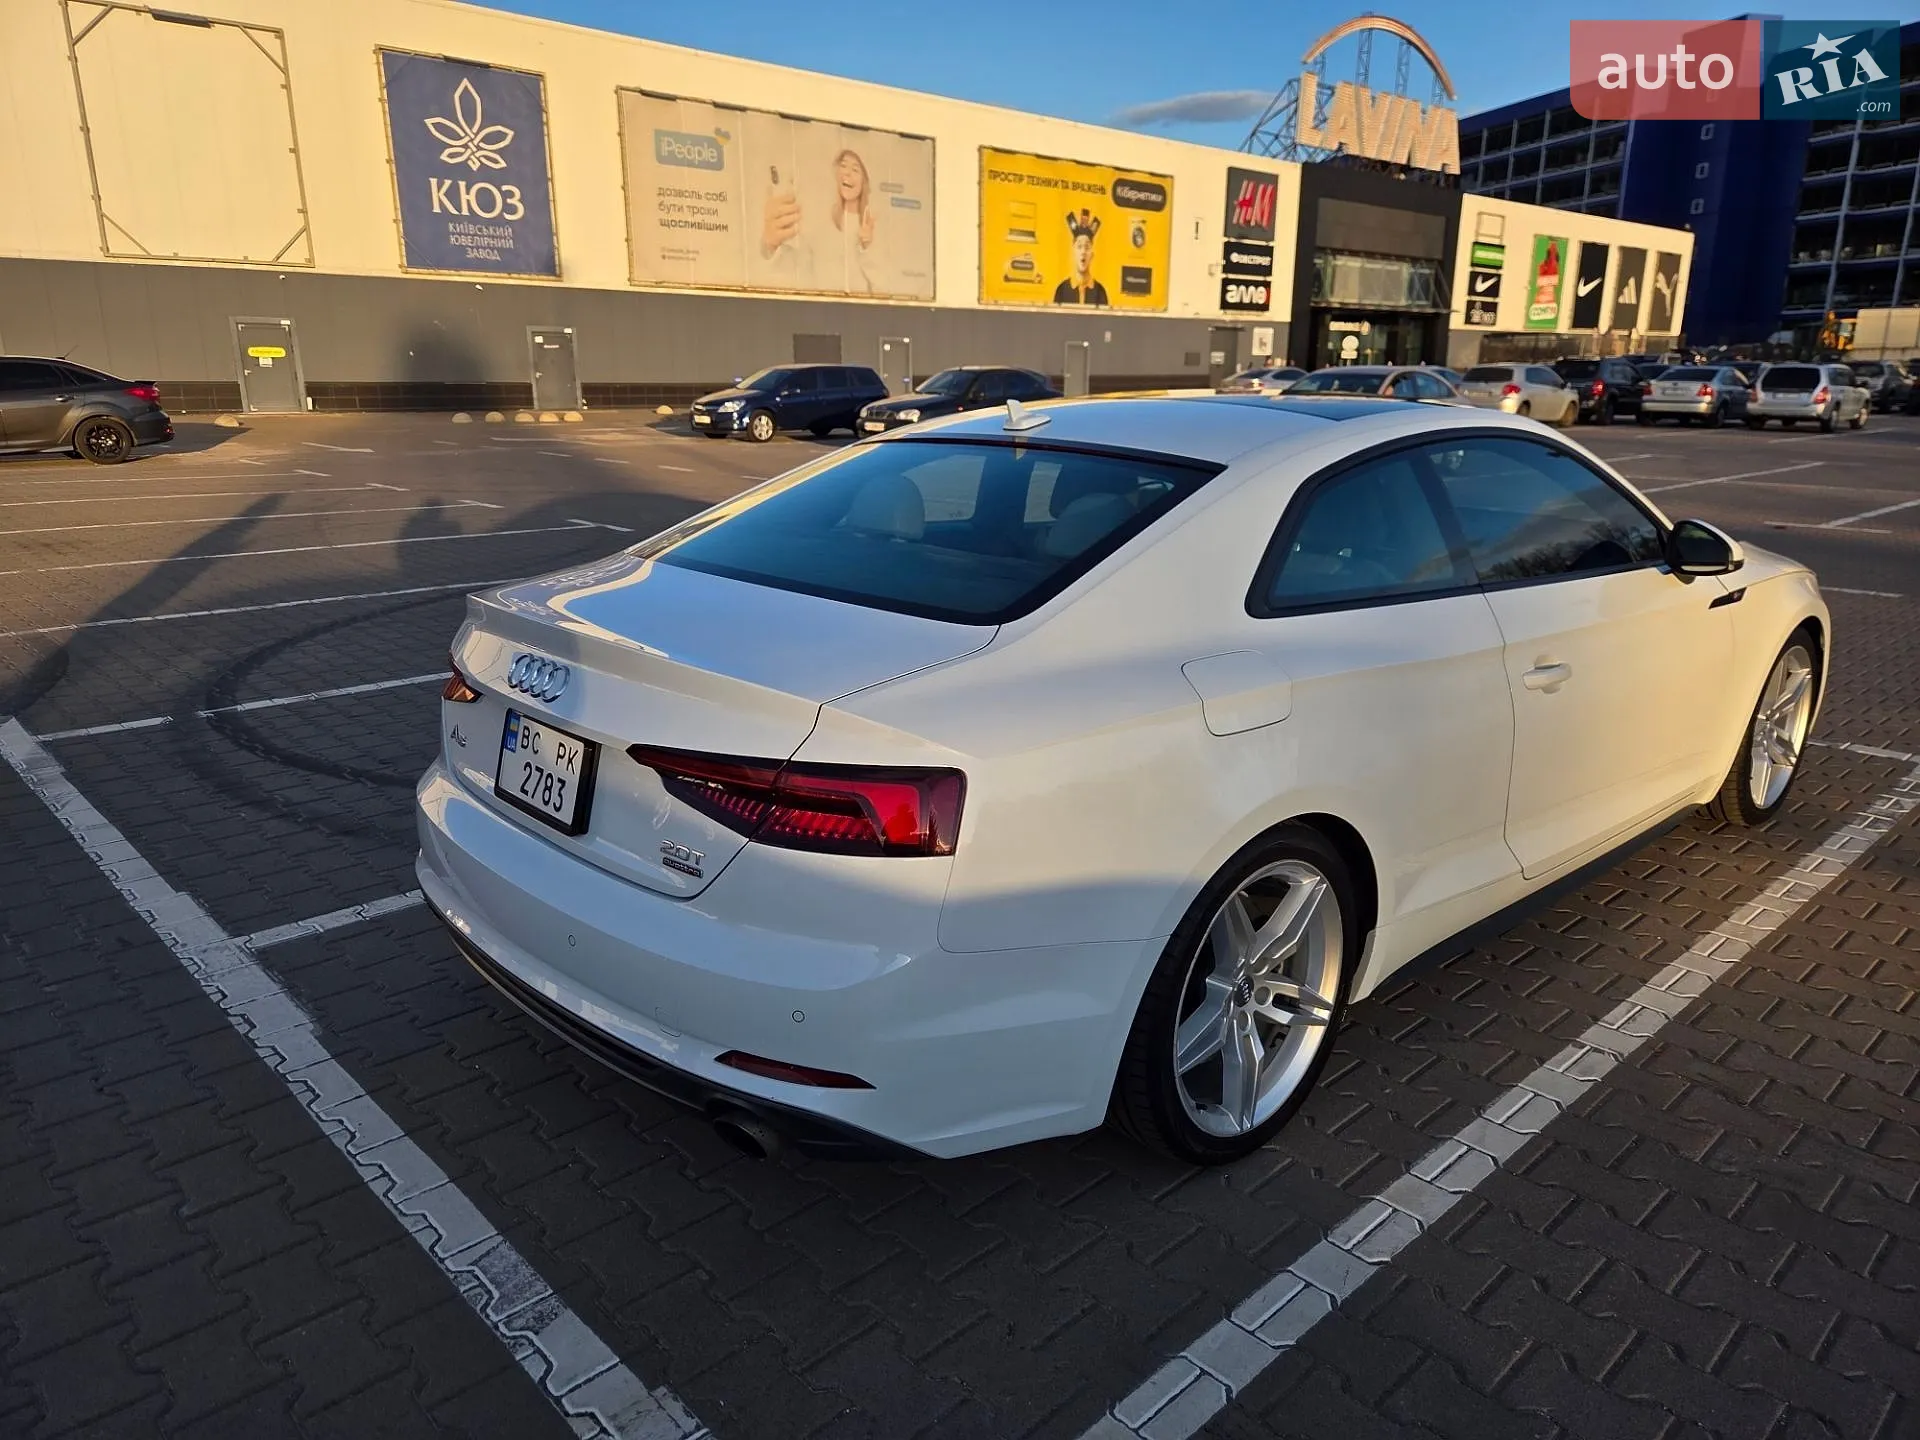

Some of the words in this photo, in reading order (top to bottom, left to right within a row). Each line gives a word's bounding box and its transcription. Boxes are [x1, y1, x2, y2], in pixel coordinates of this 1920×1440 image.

[1296, 70, 1461, 175] LAVINA
[661, 136, 718, 164] iPeople
[428, 177, 525, 221] КЮЗ
[657, 186, 703, 200] дозволь
[704, 190, 728, 202] собі
[658, 200, 684, 214] бути
[448, 222, 513, 237] КИЇВСЬКИЙ
[450, 235, 514, 249] ЮВЕЛІРНИЙ
[465, 247, 501, 261] ЗАВОД
[521, 725, 541, 755] BC
[556, 741, 579, 775] PK
[520, 761, 567, 812] 2783
